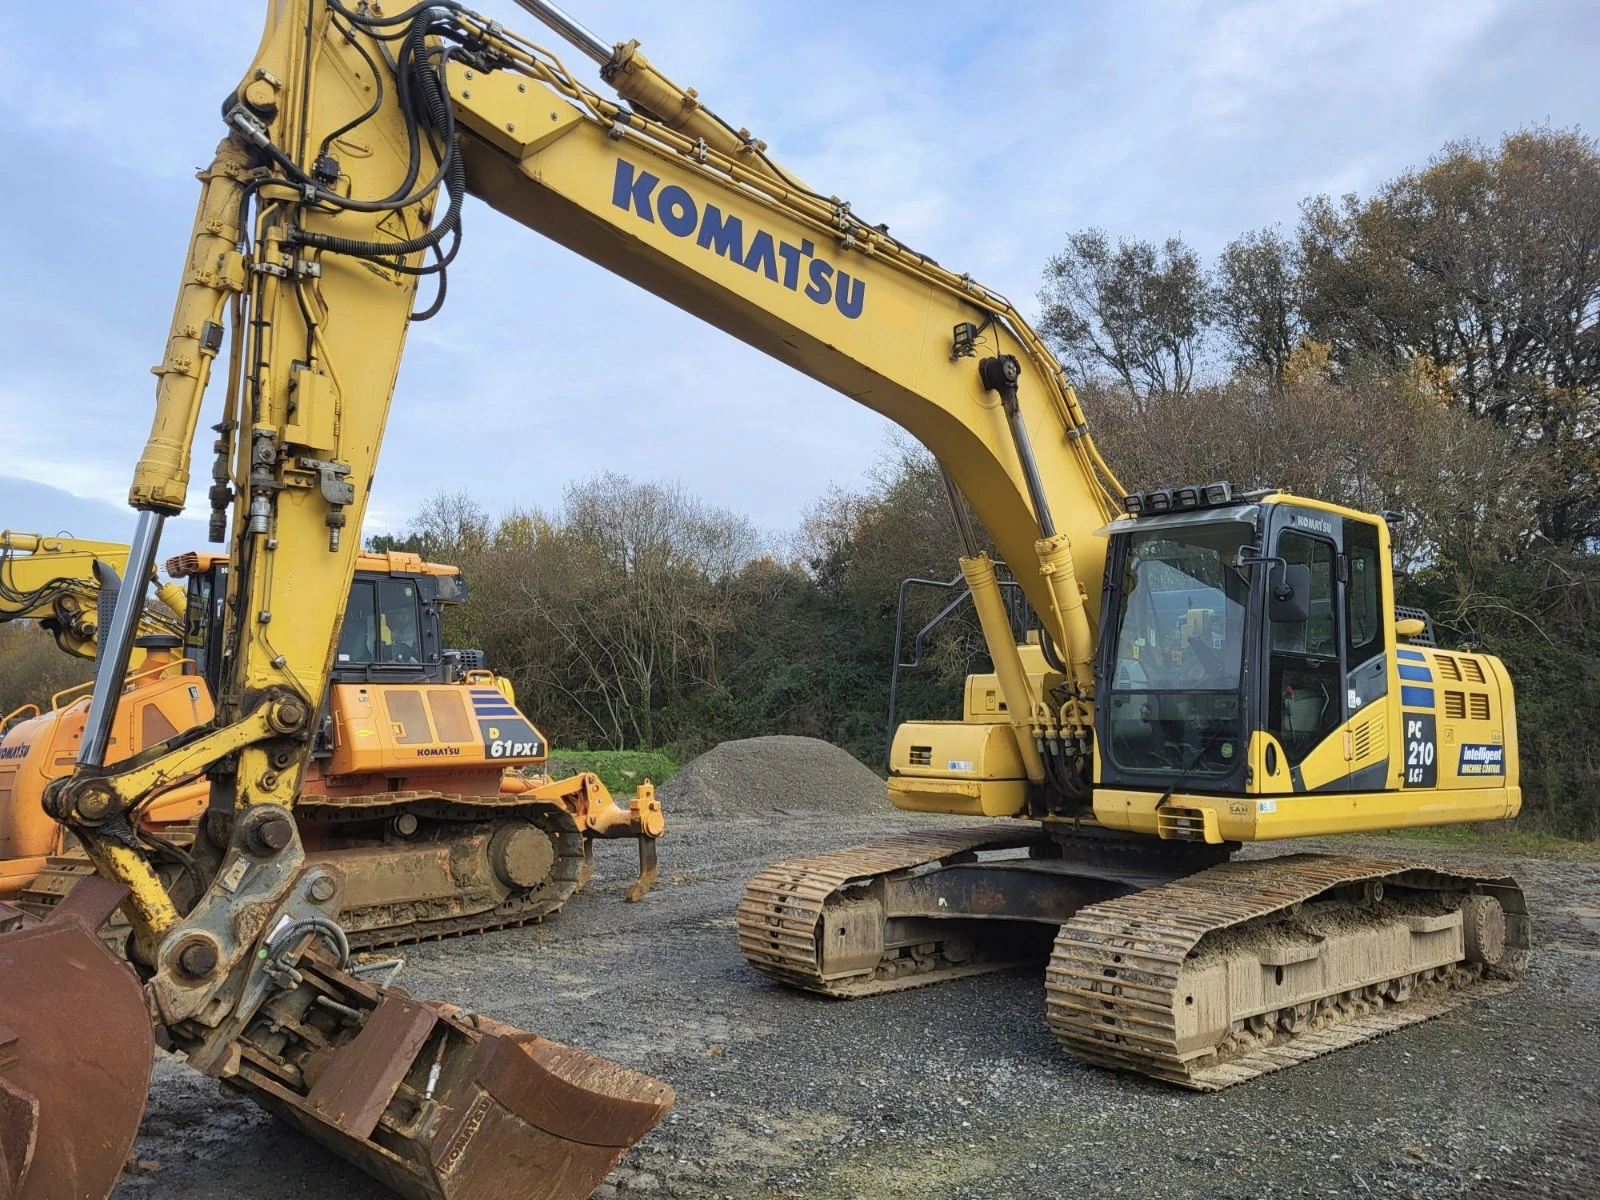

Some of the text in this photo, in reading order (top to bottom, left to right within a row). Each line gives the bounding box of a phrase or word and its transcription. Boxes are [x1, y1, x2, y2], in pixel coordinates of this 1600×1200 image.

[611, 157, 866, 320] KOMATSU
[1297, 515, 1332, 534] KOMATSU
[488, 727, 500, 740] D
[1407, 720, 1423, 739] PC
[0, 742, 31, 760] OMATSU
[417, 745, 460, 757] KOMATSU
[490, 740, 539, 758] 61PXi
[1407, 741, 1434, 766] 210
[1463, 746, 1502, 764] intelligent
[440, 1097, 492, 1174] KOMATSU
